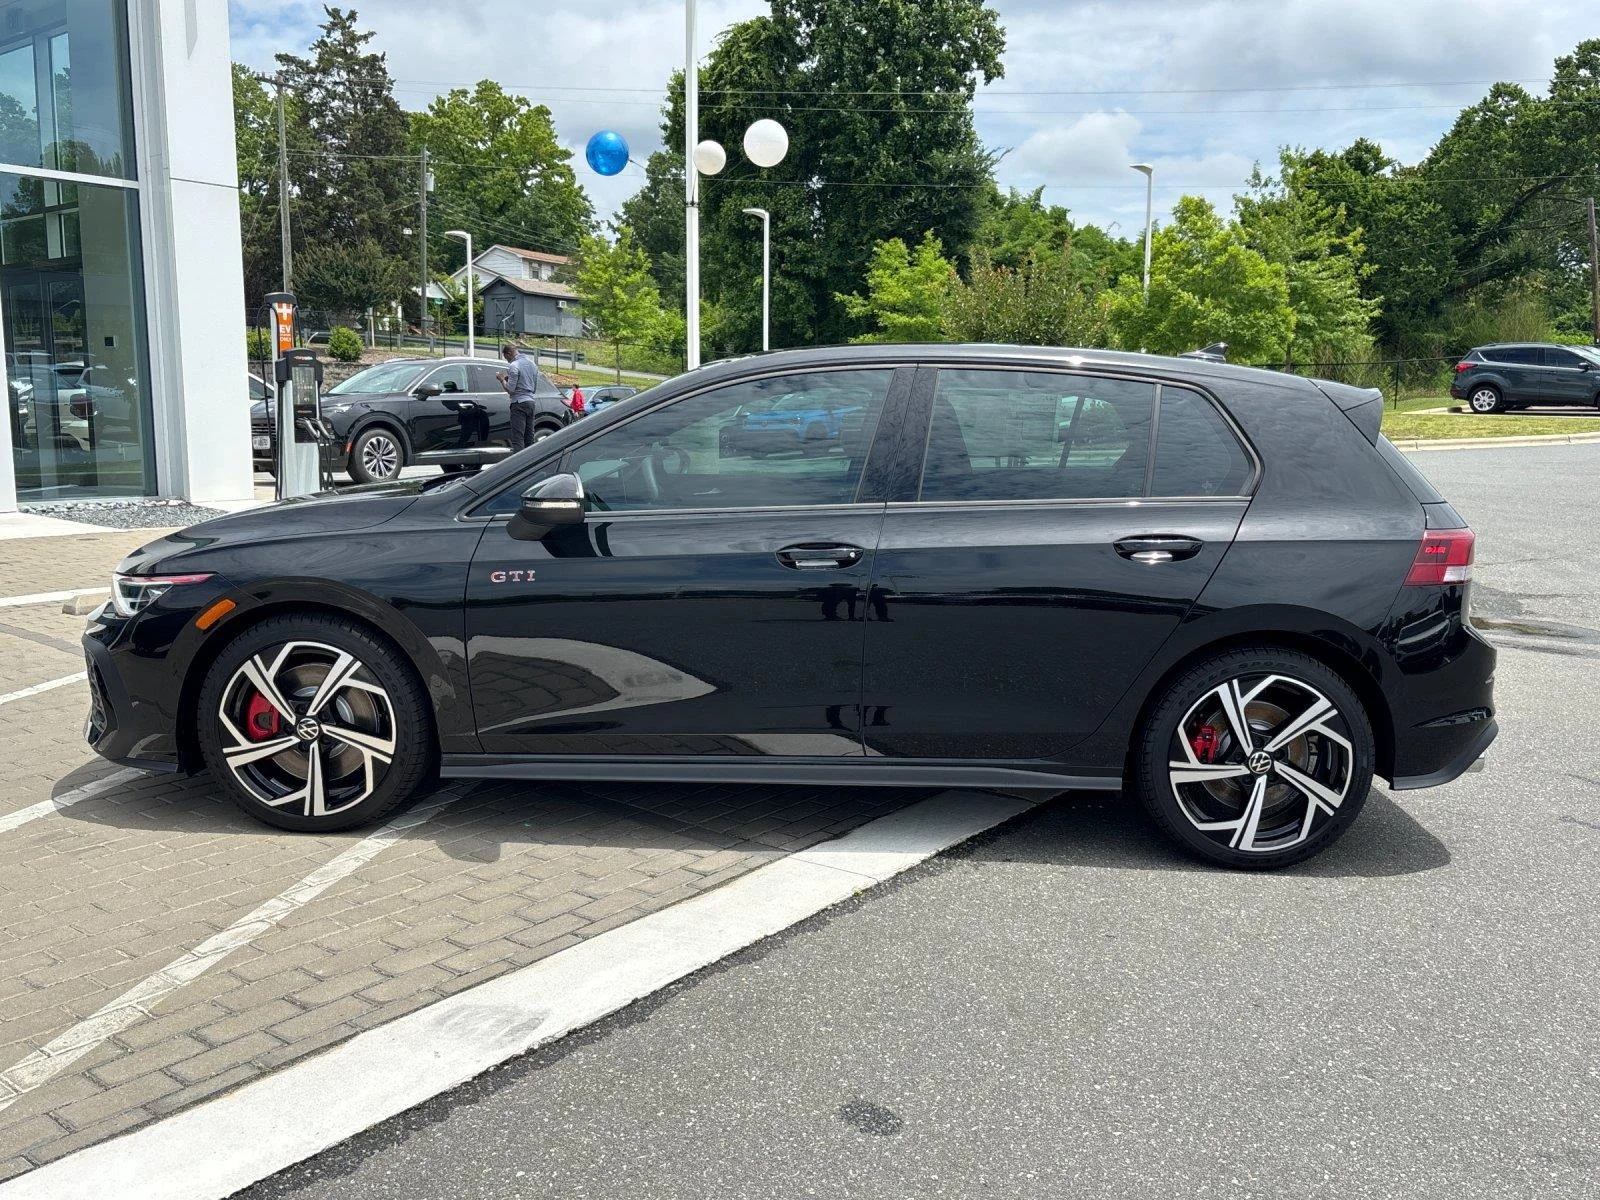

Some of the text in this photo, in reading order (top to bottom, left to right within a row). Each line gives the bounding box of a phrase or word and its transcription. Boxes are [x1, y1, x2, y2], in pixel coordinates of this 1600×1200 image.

[280, 324, 291, 333] EV
[490, 570, 536, 583] GTI
[1238, 661, 1299, 670] SPORT
